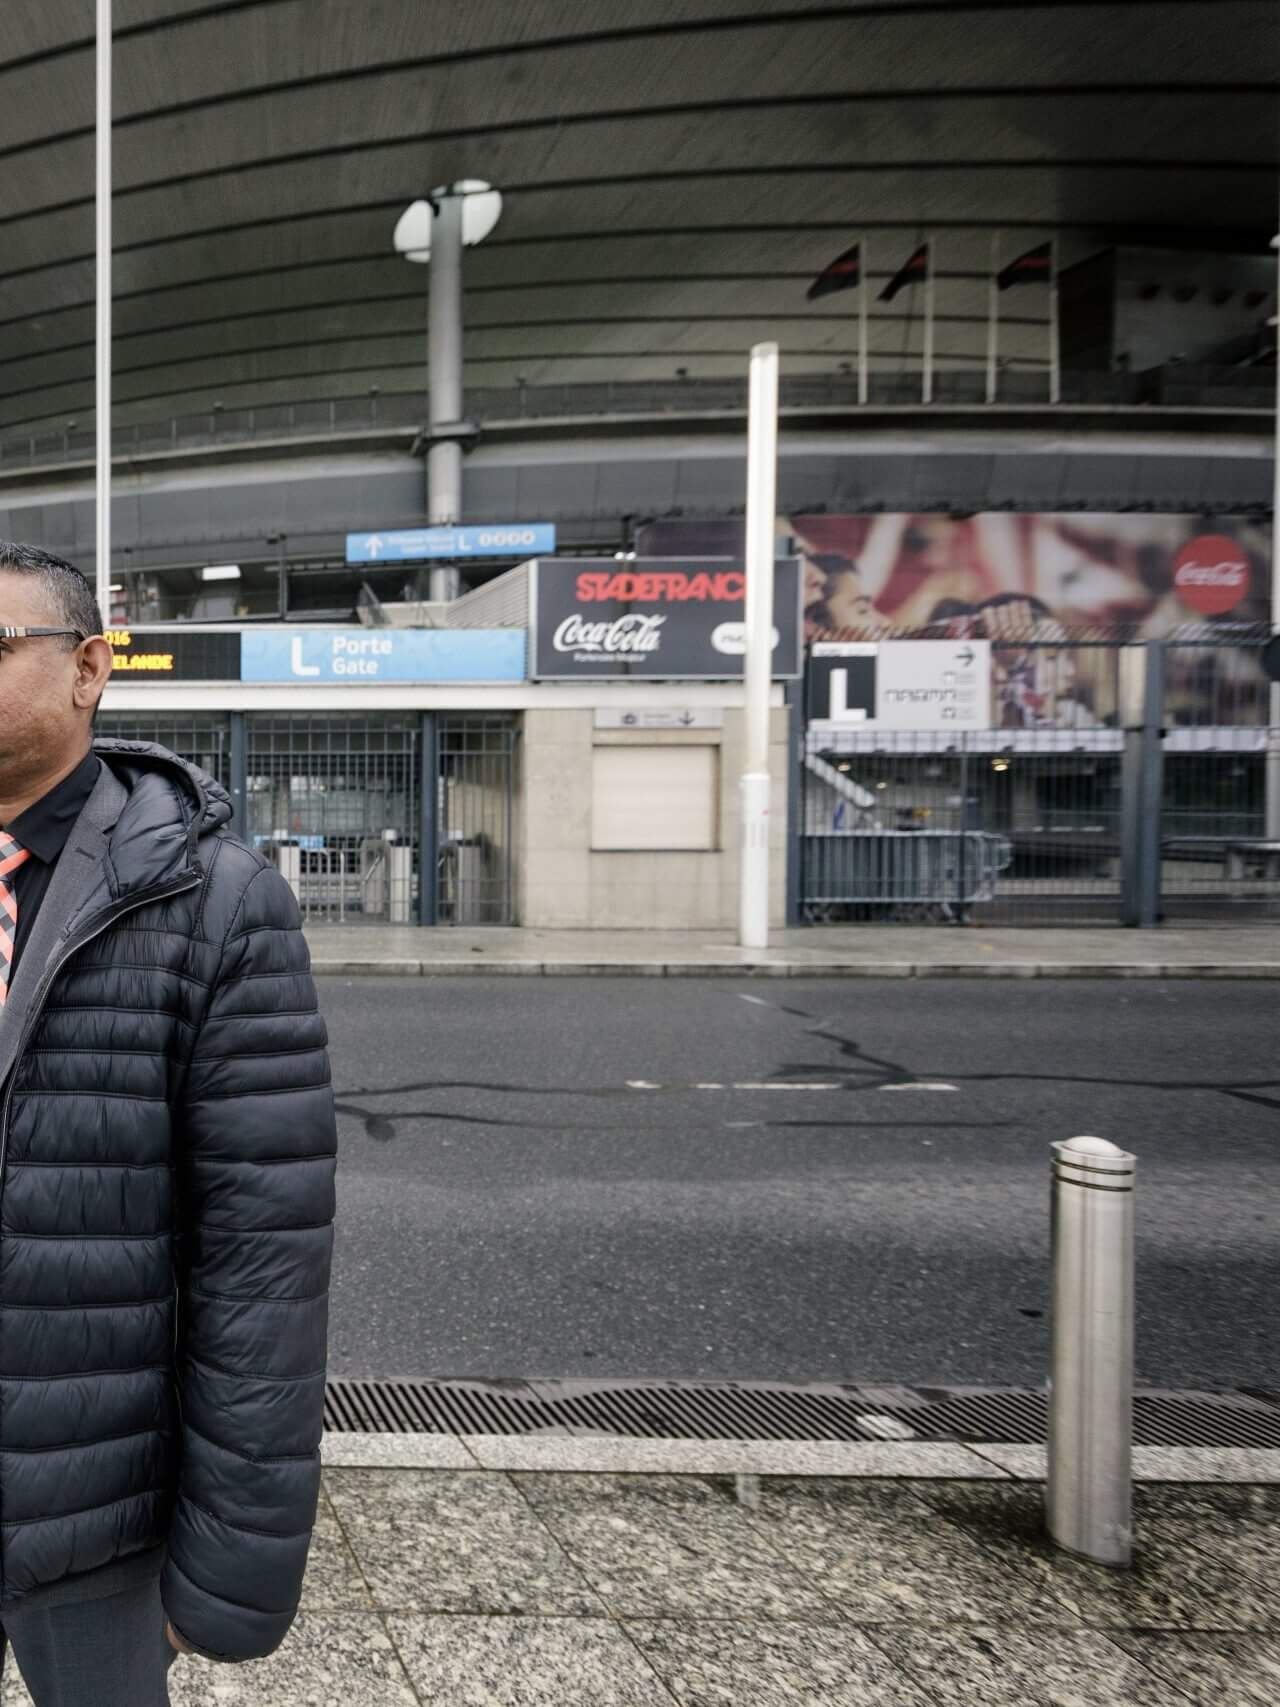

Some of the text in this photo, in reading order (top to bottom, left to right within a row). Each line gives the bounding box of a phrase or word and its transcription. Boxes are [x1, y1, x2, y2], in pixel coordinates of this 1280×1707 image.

[576, 571, 746, 602] STADEFRANC
[104, 630, 131, 646] 016
[552, 613, 667, 652] Coca-Cola
[291, 637, 320, 676] L
[332, 637, 393, 654] Porte
[112, 654, 173, 670] ELANDE
[332, 658, 379, 675] Gate
[829, 668, 867, 720] L
